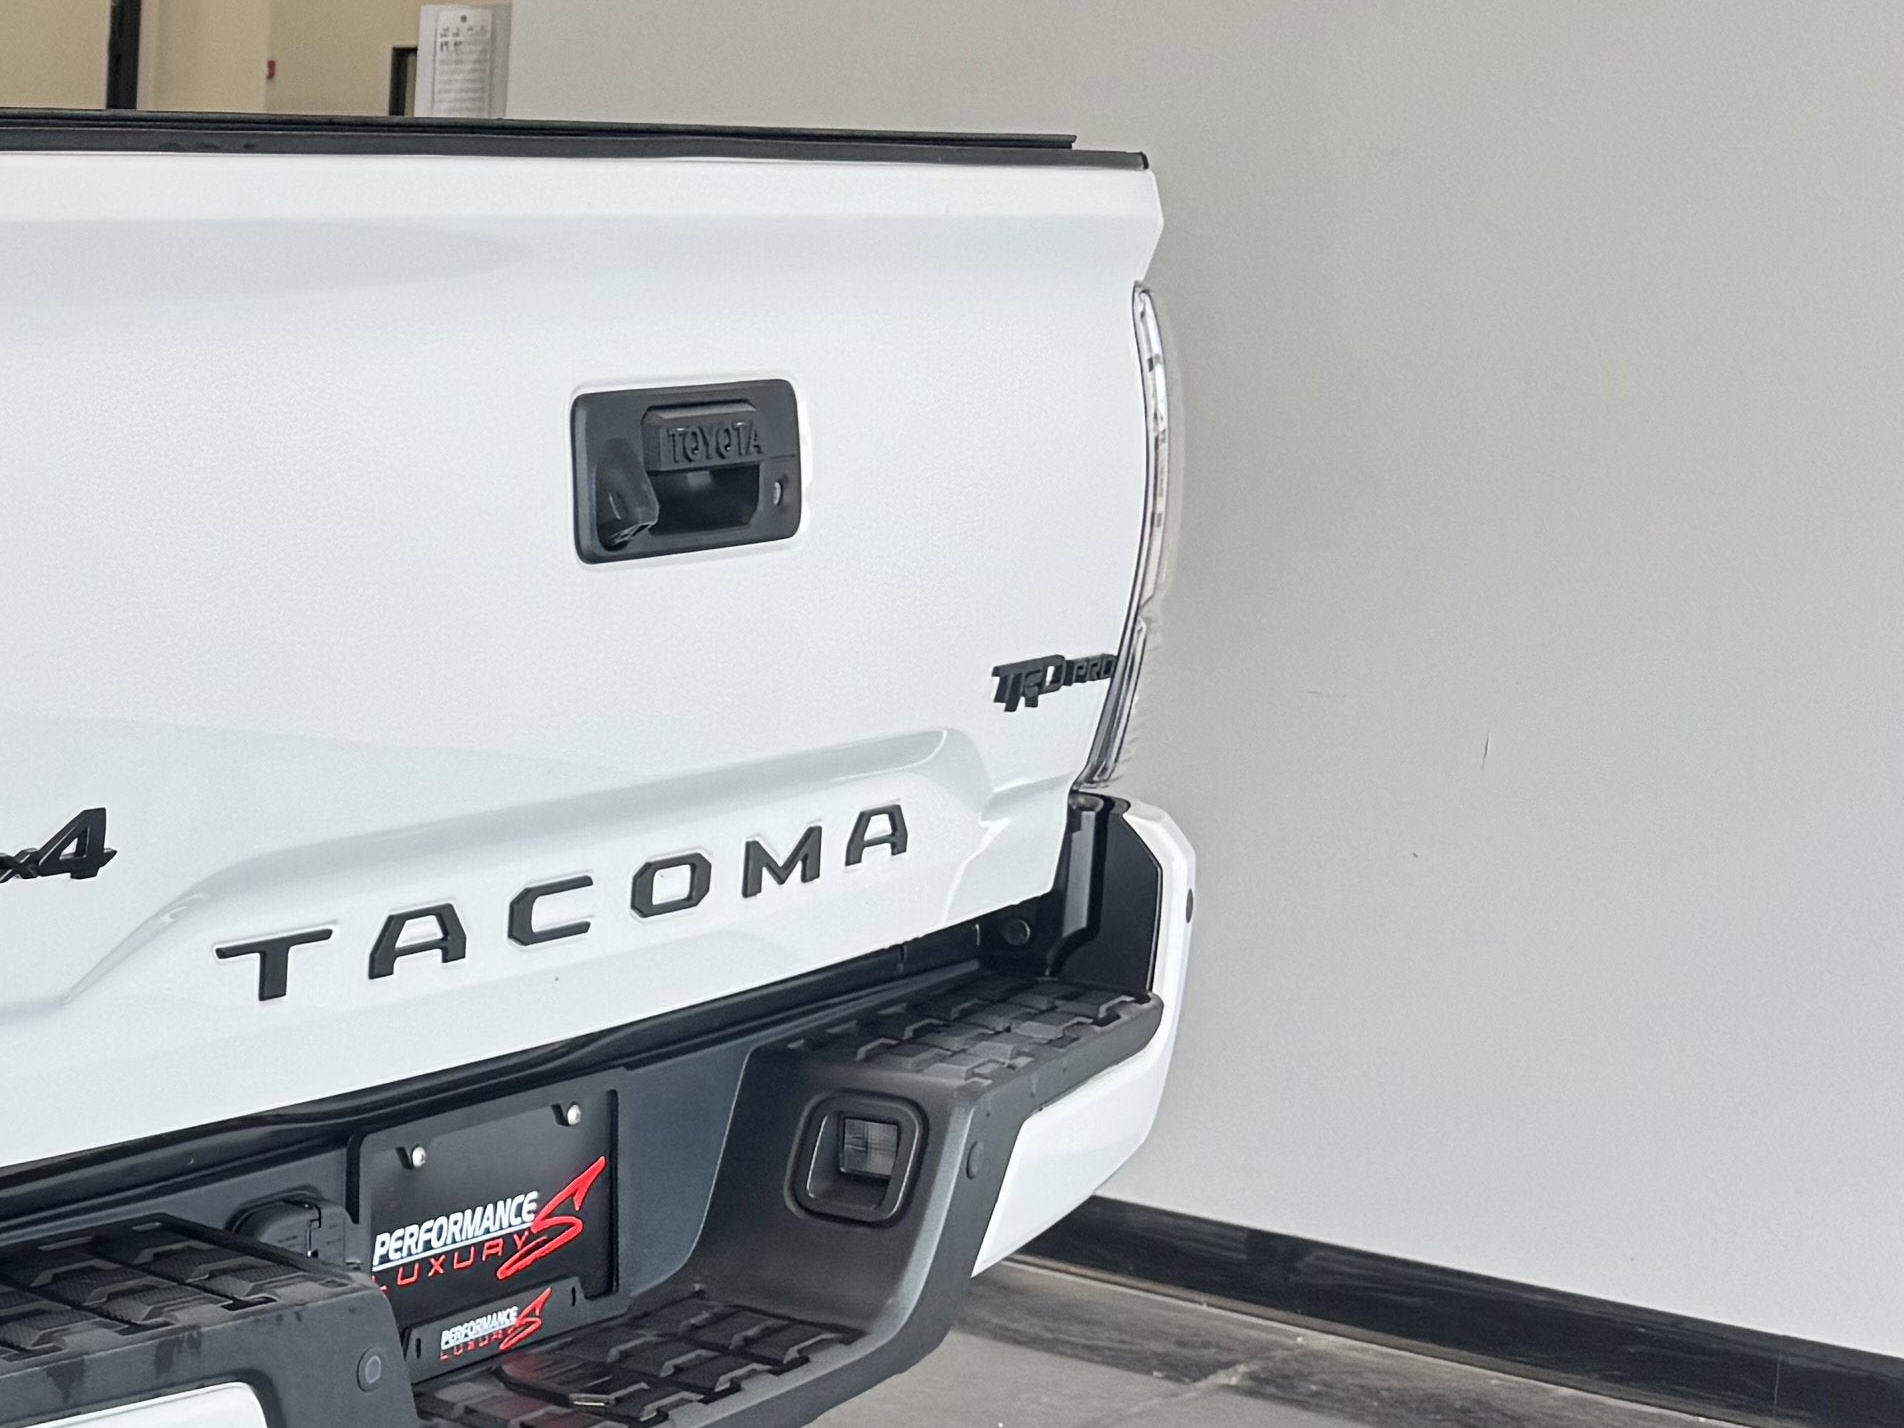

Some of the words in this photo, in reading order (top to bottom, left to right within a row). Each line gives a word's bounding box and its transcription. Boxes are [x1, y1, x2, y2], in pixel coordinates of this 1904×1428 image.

[666, 421, 763, 464] TOYOTA
[991, 654, 1066, 712] TRD
[215, 803, 909, 1002] TACOMA
[372, 1190, 539, 1267] PERFORMANCE
[440, 1305, 519, 1350] PERFORMANCE
